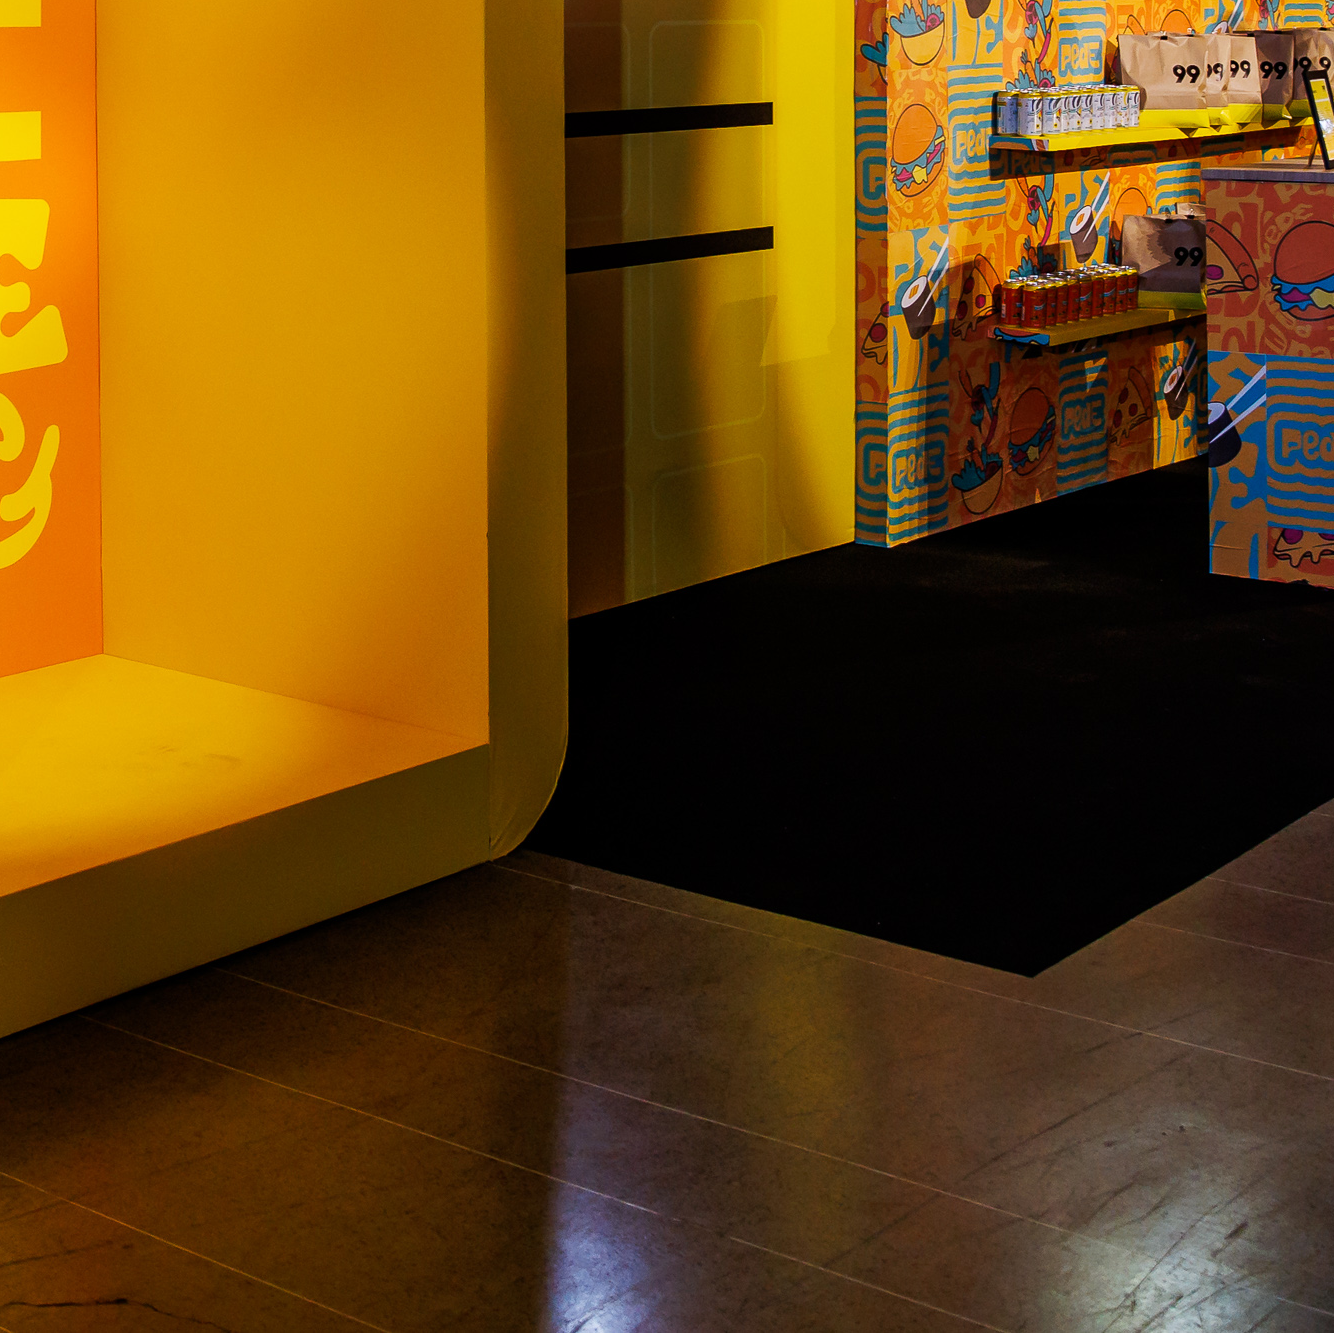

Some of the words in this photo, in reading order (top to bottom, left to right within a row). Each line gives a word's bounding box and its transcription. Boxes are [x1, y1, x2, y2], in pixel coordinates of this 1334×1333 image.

[1172, 65, 1200, 84] 99
[1260, 61, 1287, 80] 99
[1174, 247, 1204, 266] 99
